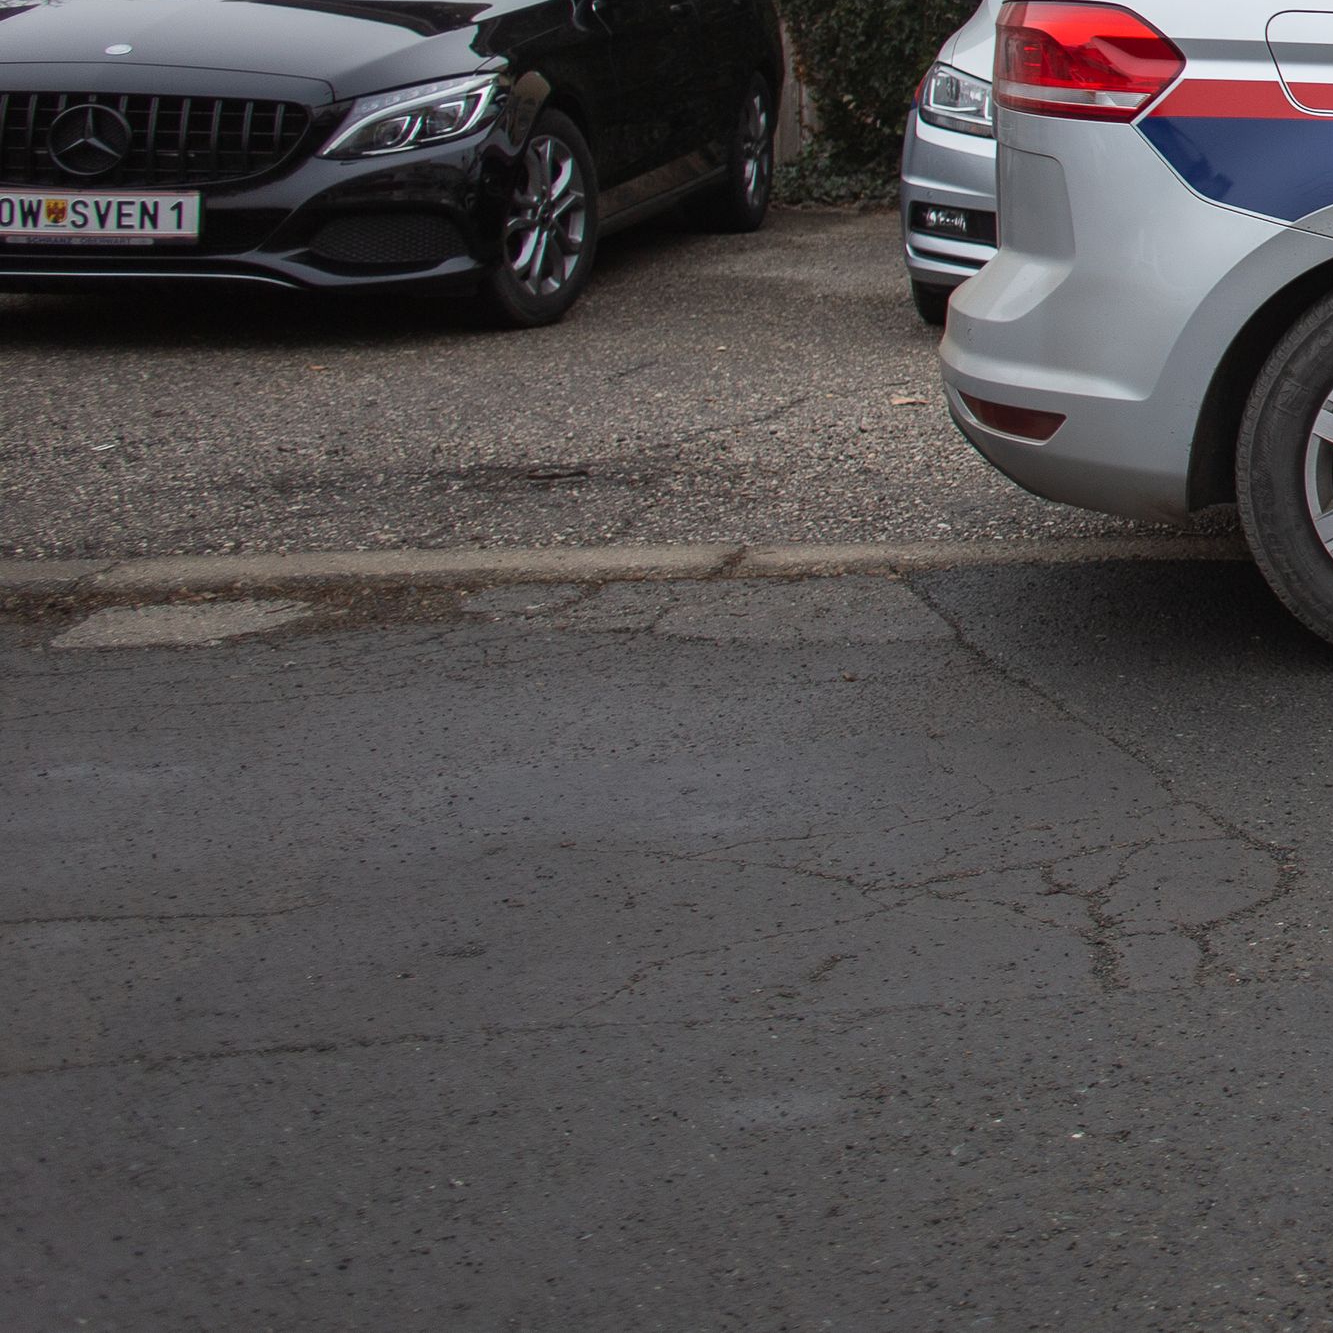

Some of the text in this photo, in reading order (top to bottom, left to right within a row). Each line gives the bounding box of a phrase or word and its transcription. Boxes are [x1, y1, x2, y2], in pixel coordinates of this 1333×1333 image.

[0, 197, 184, 230] OW SVEN 1
